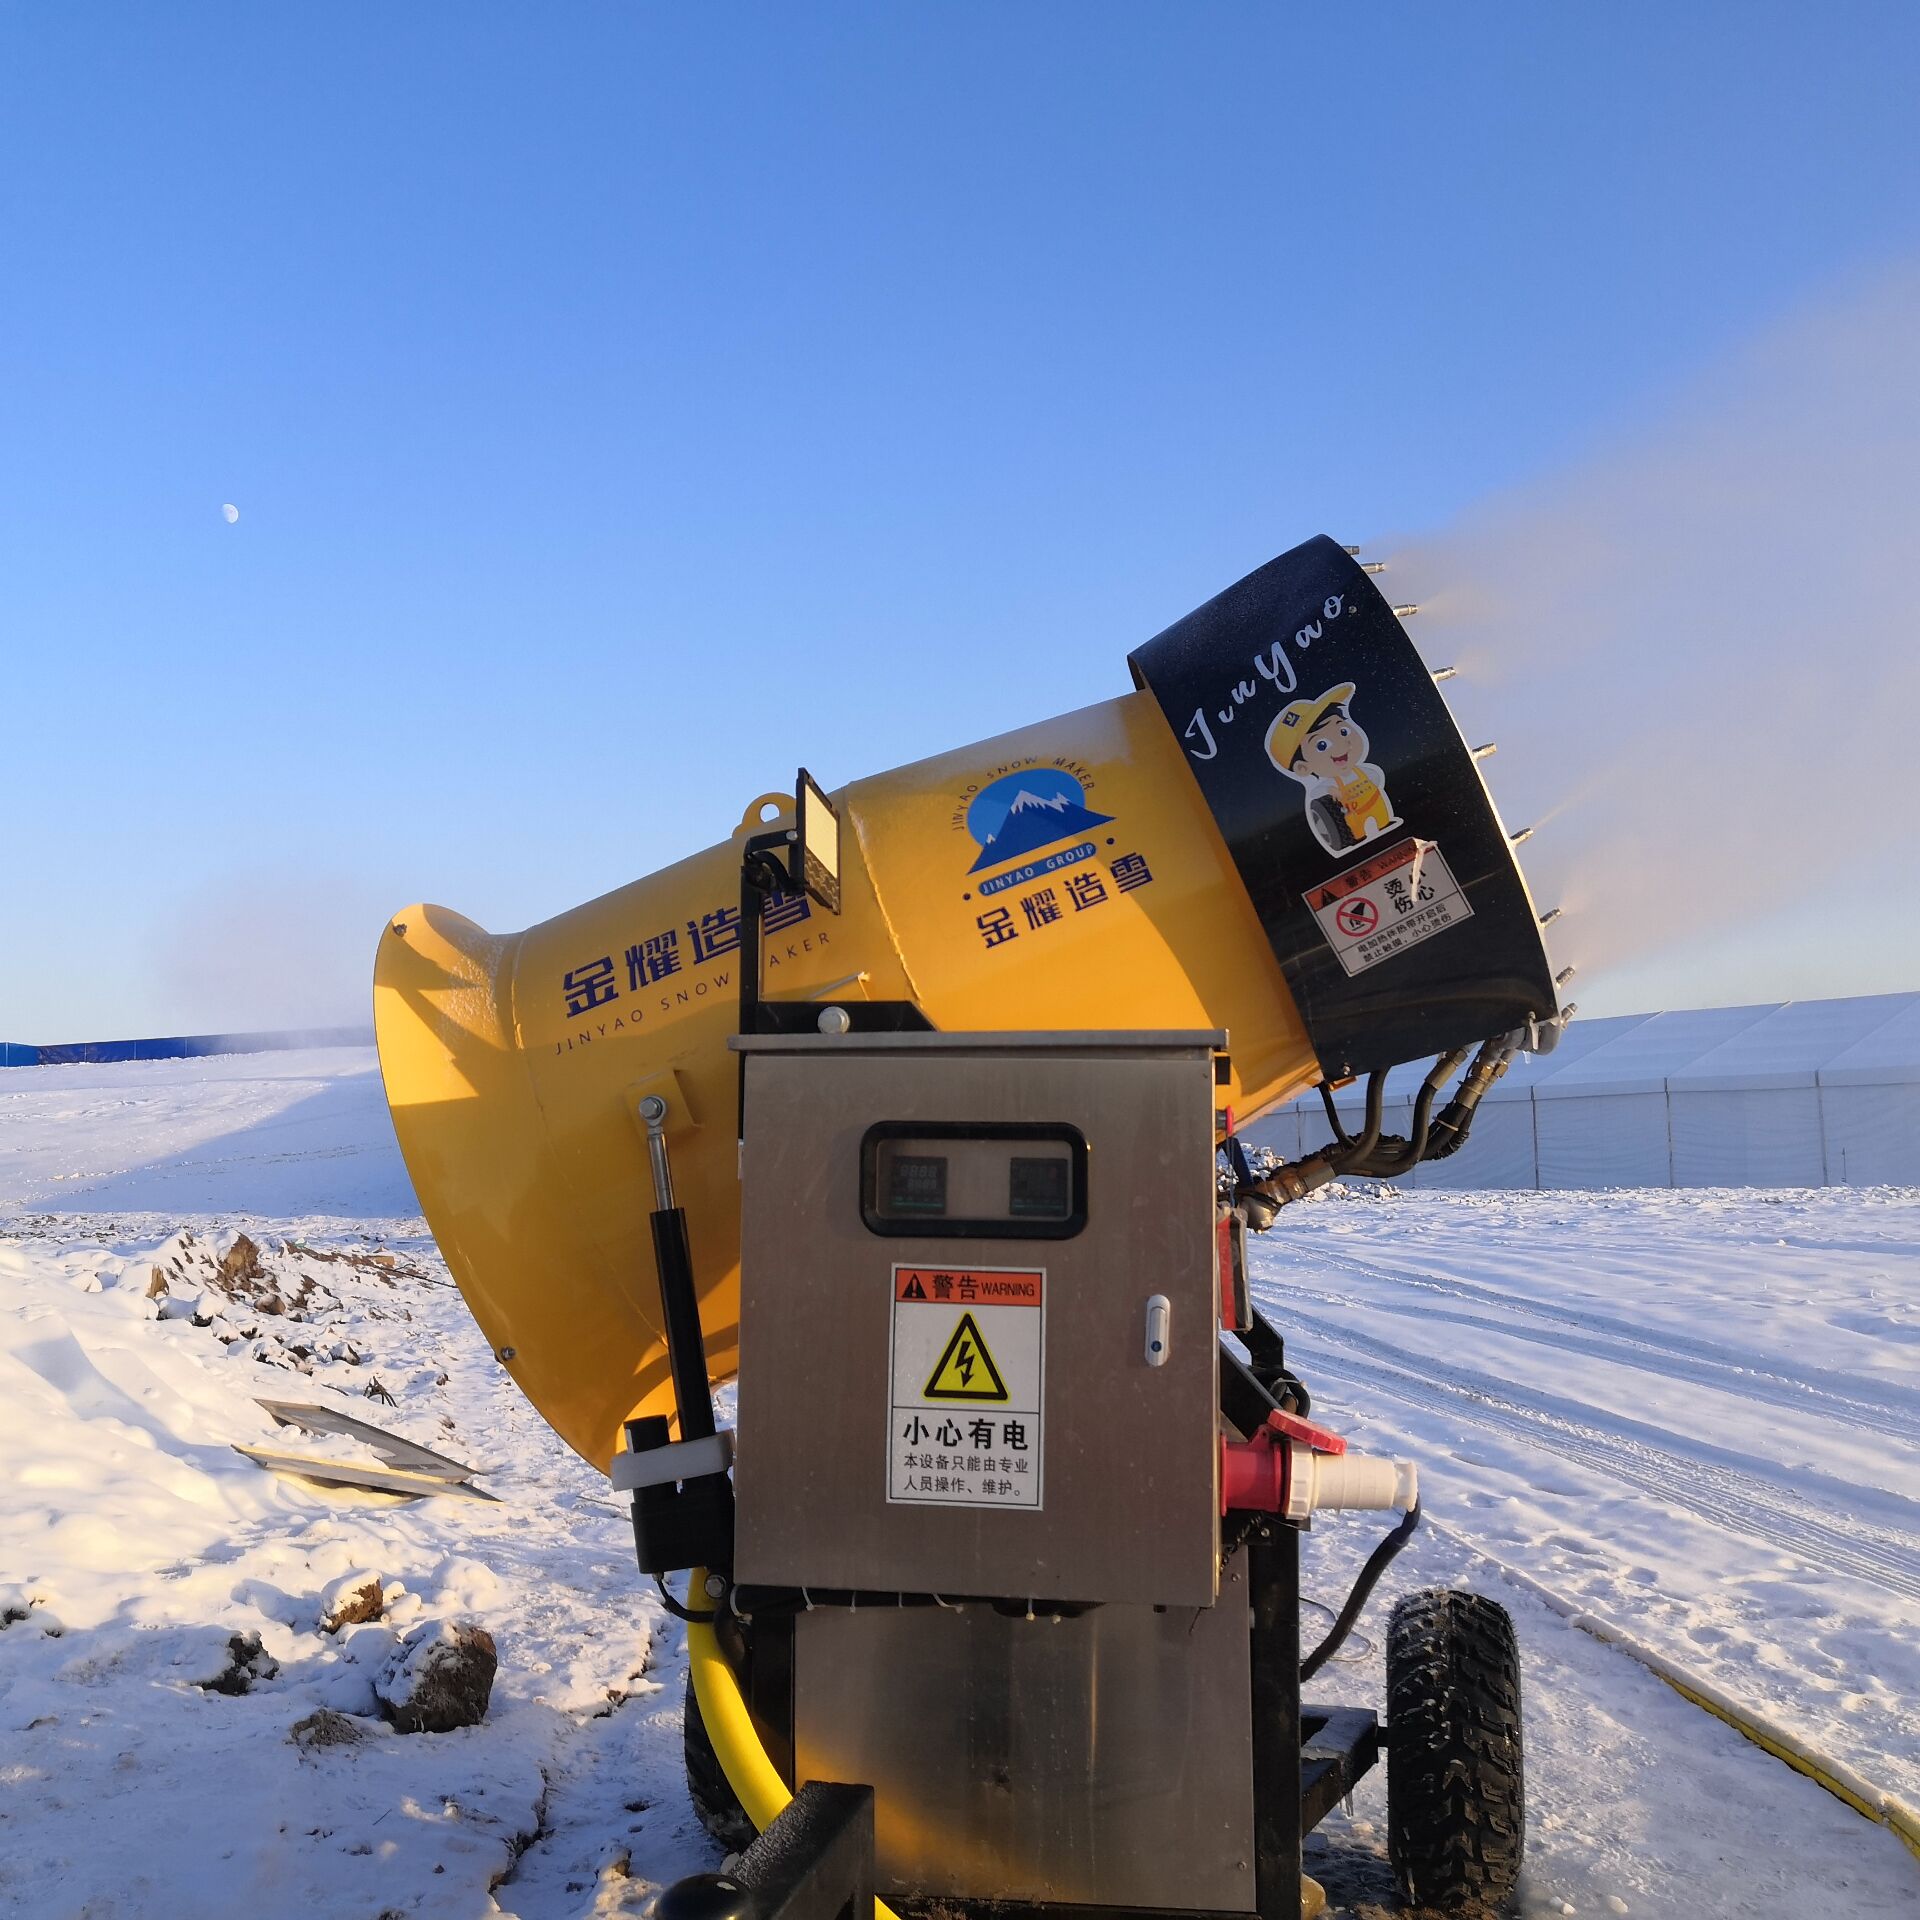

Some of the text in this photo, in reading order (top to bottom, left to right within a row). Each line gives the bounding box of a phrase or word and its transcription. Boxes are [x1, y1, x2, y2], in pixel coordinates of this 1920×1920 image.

[952, 757, 1095, 831] JINYAO SNOW MAKER
[981, 844, 1095, 894] JINYAO GROUP
[1345, 869, 1372, 889] 警告
[976, 852, 1153, 949] 金耀造雪
[556, 931, 830, 1055] JINYAO SNOW AKER
[932, 1273, 1035, 1300] 警告 WARNING
[903, 1415, 1028, 1451] 小心有电
[903, 1453, 1029, 1474] 本设备只能由专业
[903, 1475, 1022, 1497] 人员操作、维护。
